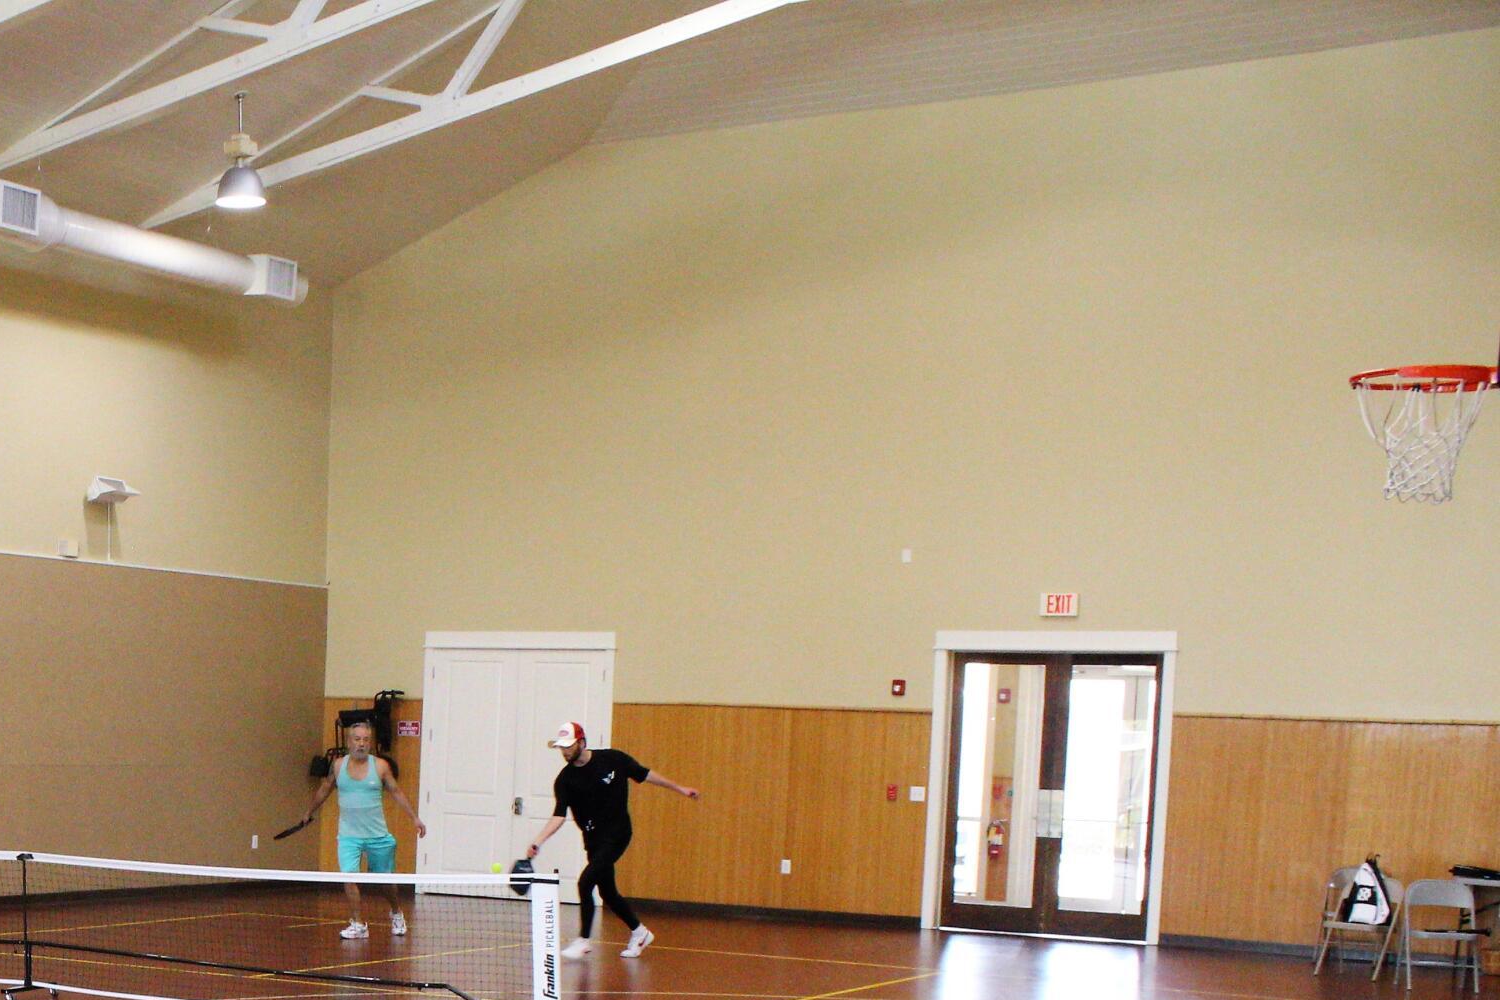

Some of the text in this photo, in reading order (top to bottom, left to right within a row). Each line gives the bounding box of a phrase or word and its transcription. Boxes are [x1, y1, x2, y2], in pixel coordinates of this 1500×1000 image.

[1047, 594, 1073, 613] EXIT
[543, 900, 558, 1000] franklin PICKLEBALL
